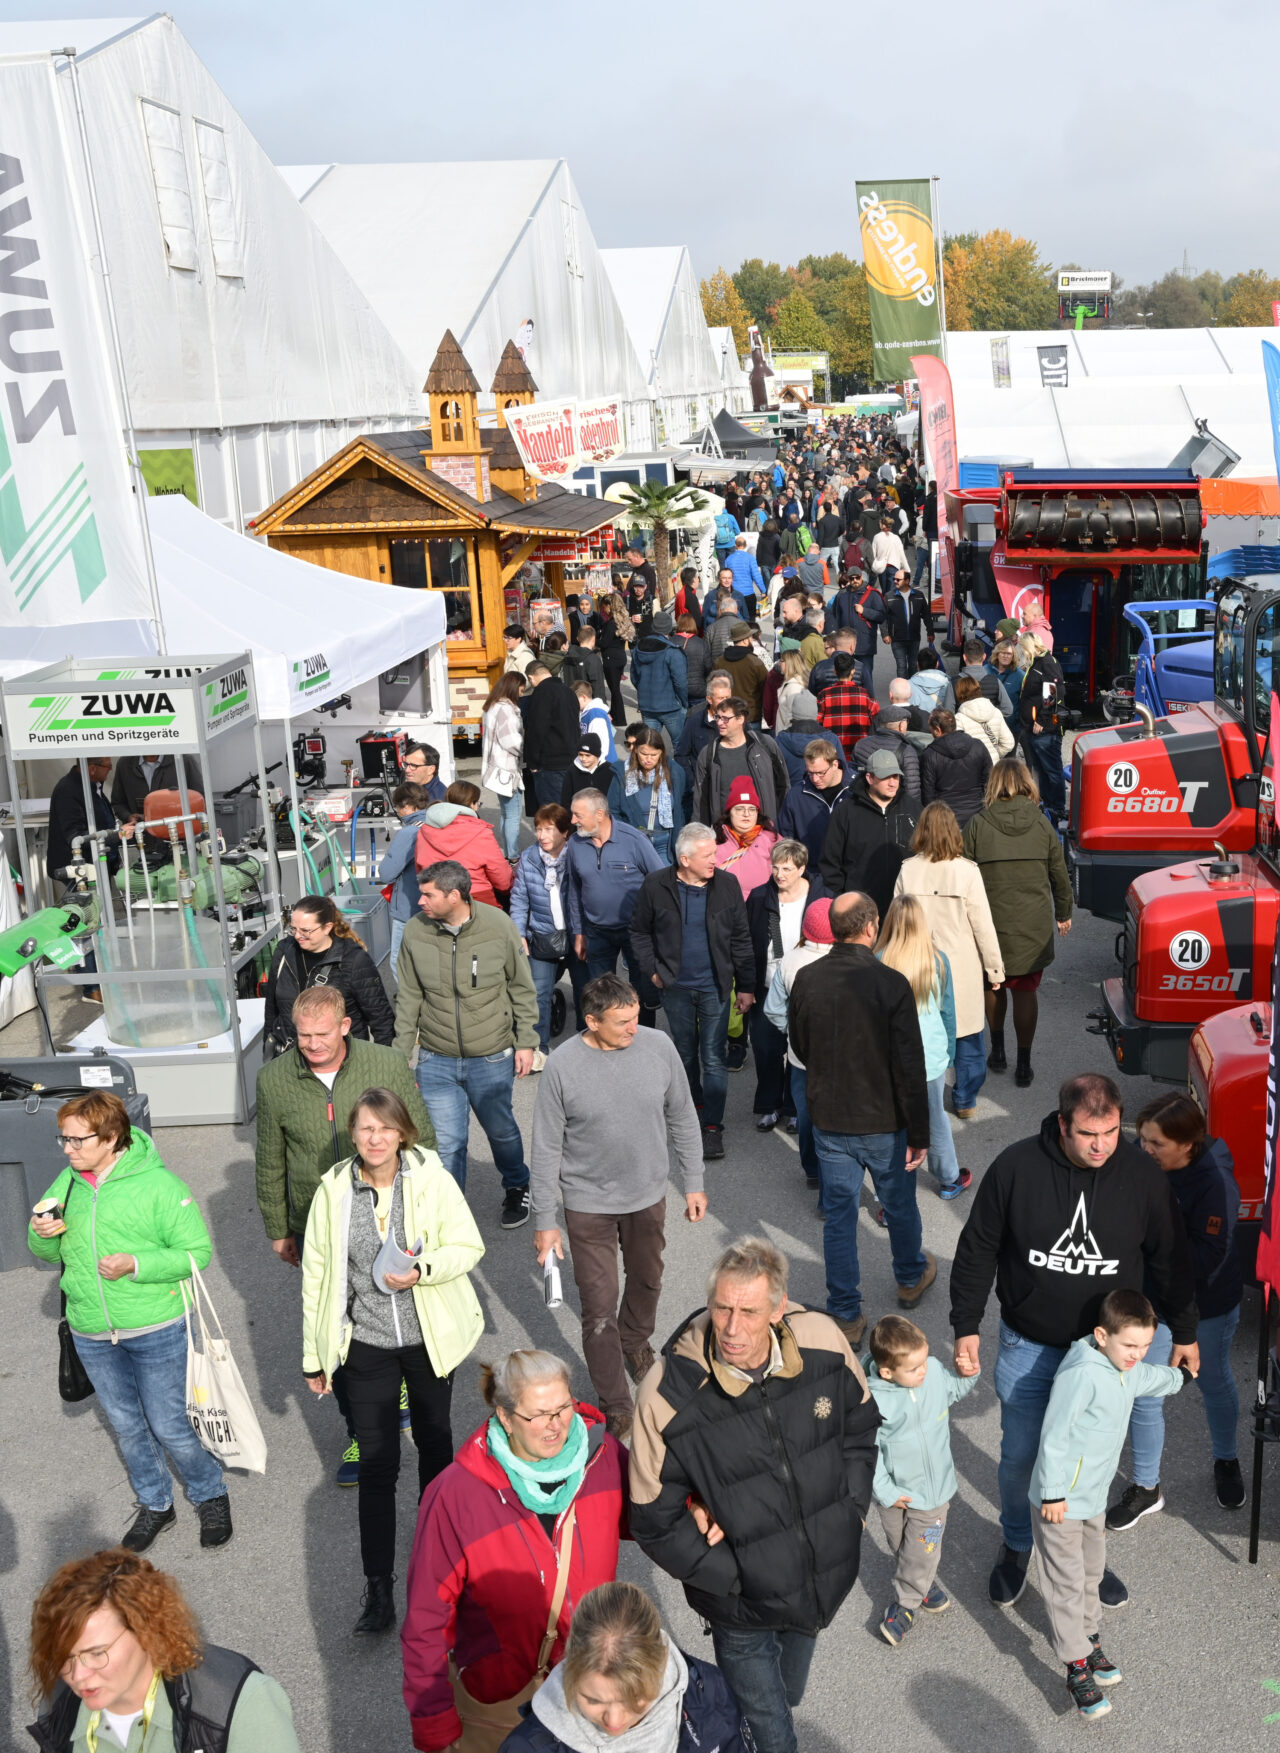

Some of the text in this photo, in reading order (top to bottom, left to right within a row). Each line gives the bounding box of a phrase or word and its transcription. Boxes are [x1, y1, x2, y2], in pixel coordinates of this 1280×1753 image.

[517, 421, 575, 464] Mandeln
[304, 653, 329, 678] ZUWA
[220, 668, 248, 698] ZUWA
[80, 692, 176, 716] ZUWA
[207, 718, 222, 731] Pumpen
[230, 702, 250, 722] Spritzgeräte
[28, 728, 180, 745] Pumpen und Spritzgeräte
[1113, 768, 1133, 788] 20
[1106, 782, 1209, 813] 6680T
[1178, 938, 1203, 963] 20
[1159, 968, 1251, 992] 3650T
[1028, 1248, 1120, 1275] DEUTZ
